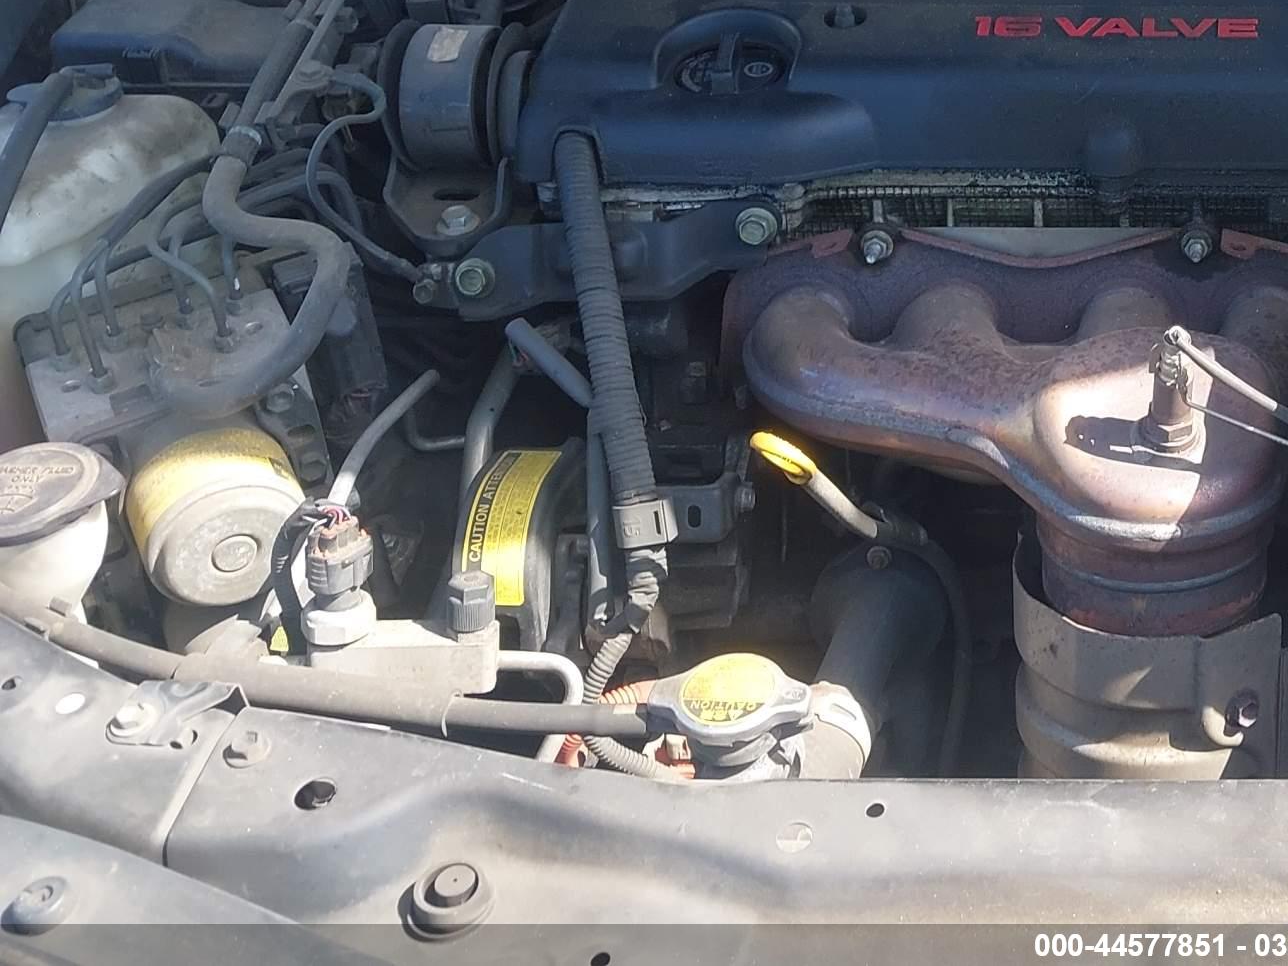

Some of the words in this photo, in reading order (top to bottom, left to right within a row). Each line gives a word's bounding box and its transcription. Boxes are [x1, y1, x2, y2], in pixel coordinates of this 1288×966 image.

[974, 15, 1043, 38] 16
[1055, 16, 1260, 39] VALVE
[468, 503, 491, 563] CAUTION
